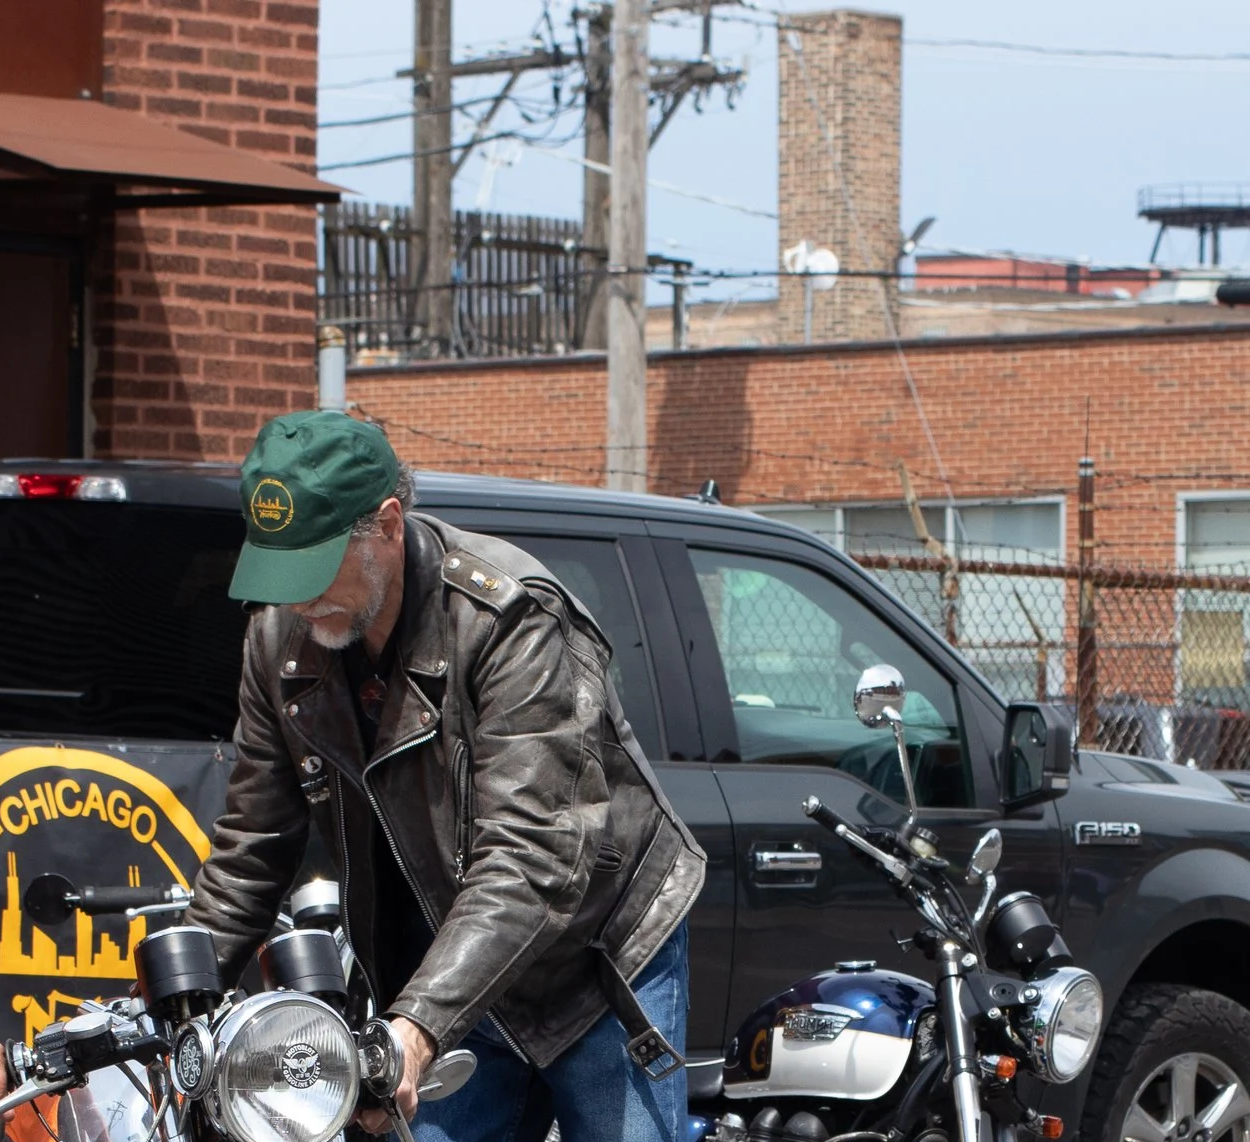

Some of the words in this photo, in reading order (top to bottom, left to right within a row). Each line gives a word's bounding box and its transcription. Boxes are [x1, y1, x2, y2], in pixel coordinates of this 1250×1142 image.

[0, 779, 157, 843] CHICAGO
[285, 1045, 316, 1058] MOTOBLOT
[282, 1069, 308, 1088] GASOLINE
[309, 1066, 321, 1085] ALLEY
